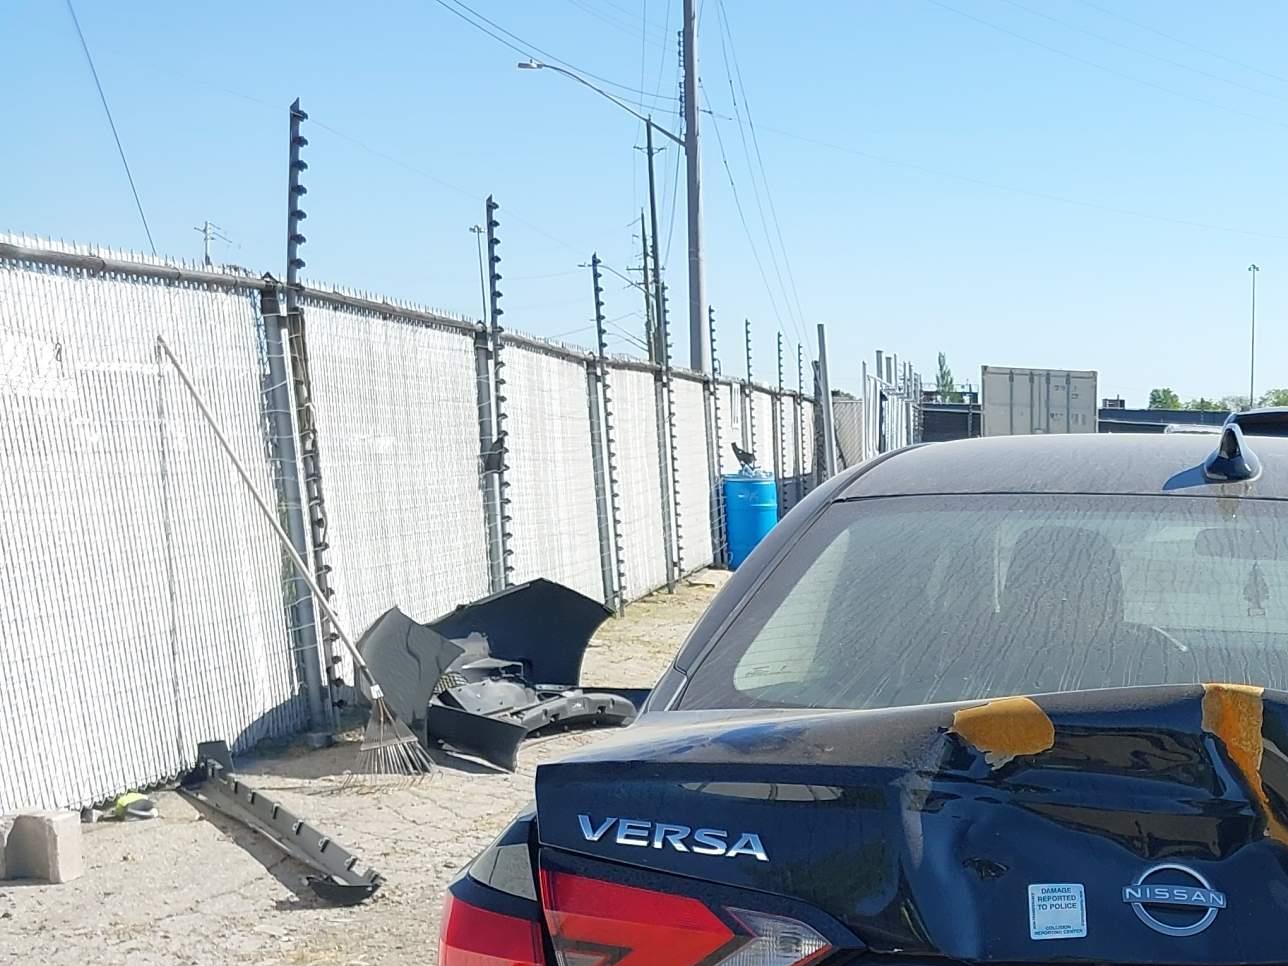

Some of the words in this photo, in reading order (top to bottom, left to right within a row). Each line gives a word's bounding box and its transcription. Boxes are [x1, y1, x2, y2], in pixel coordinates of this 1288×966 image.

[577, 814, 769, 863] VERSA
[1037, 895, 1077, 903] REPORTED
[1125, 887, 1224, 906] NISSAN
[1037, 903, 1048, 911] TO
[1050, 902, 1077, 910] POLICE
